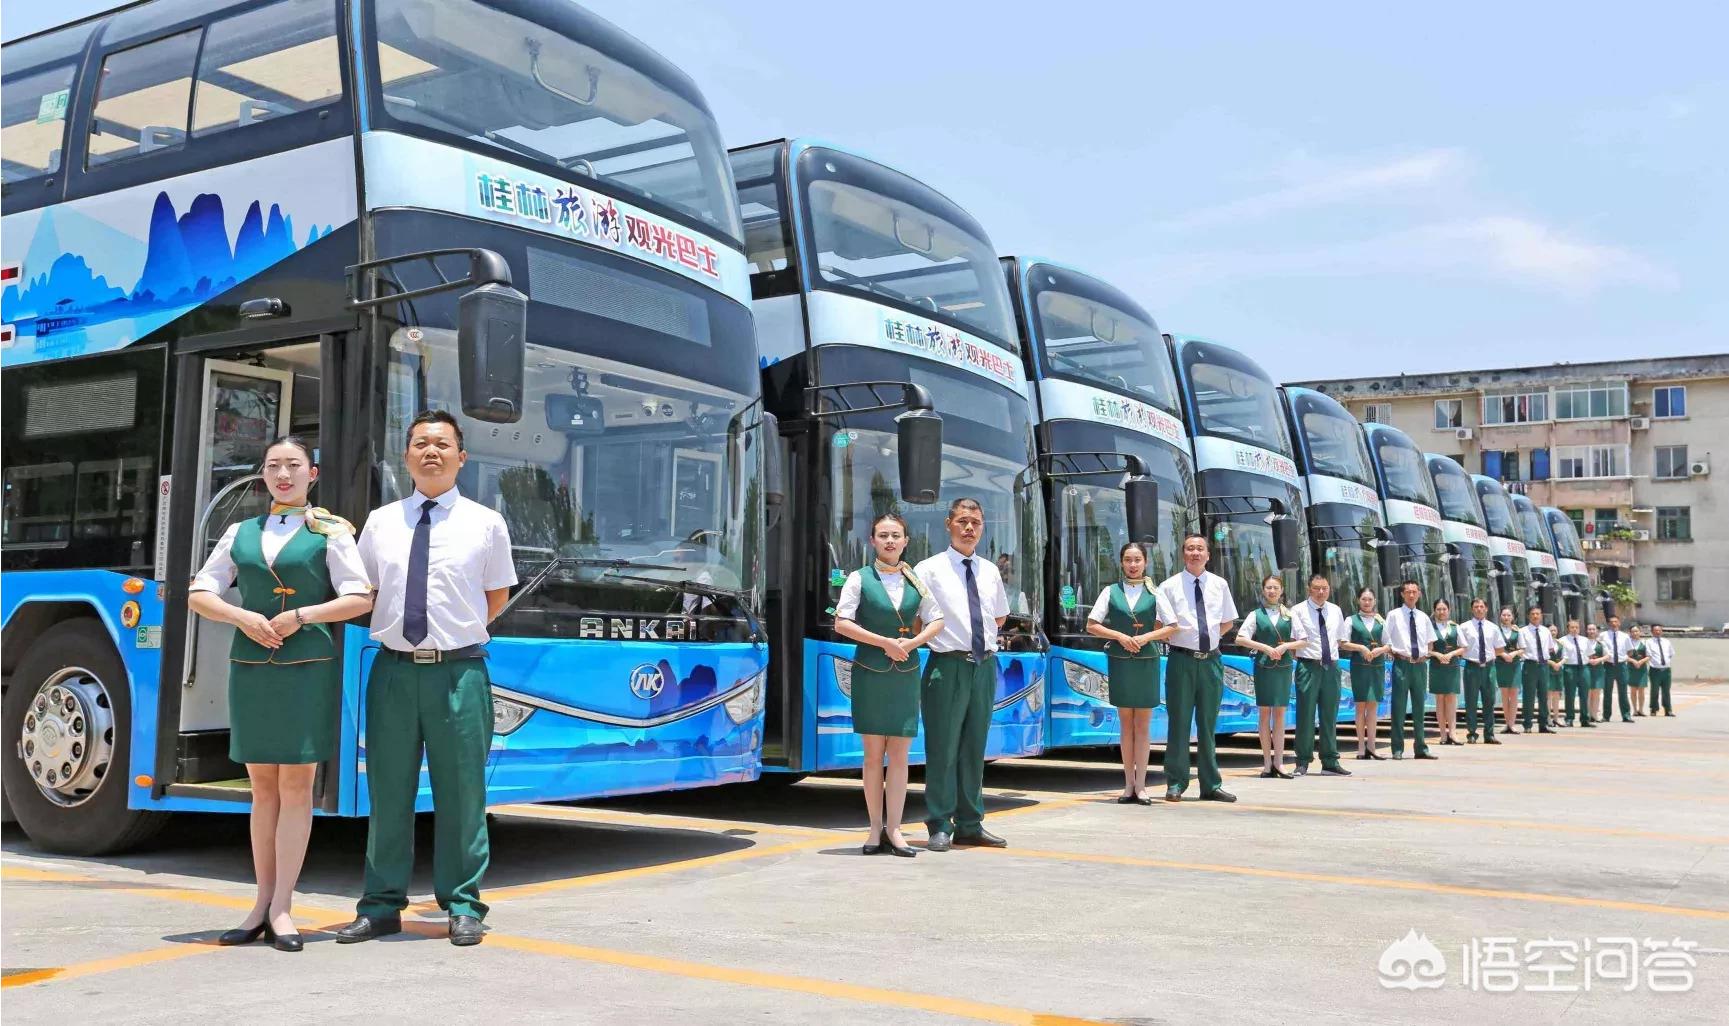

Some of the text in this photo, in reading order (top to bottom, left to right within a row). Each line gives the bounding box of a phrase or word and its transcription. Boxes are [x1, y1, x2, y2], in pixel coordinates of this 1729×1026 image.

[477, 174, 719, 277] 桂林旅游观光巴士
[579, 617, 697, 640] ANKAI
